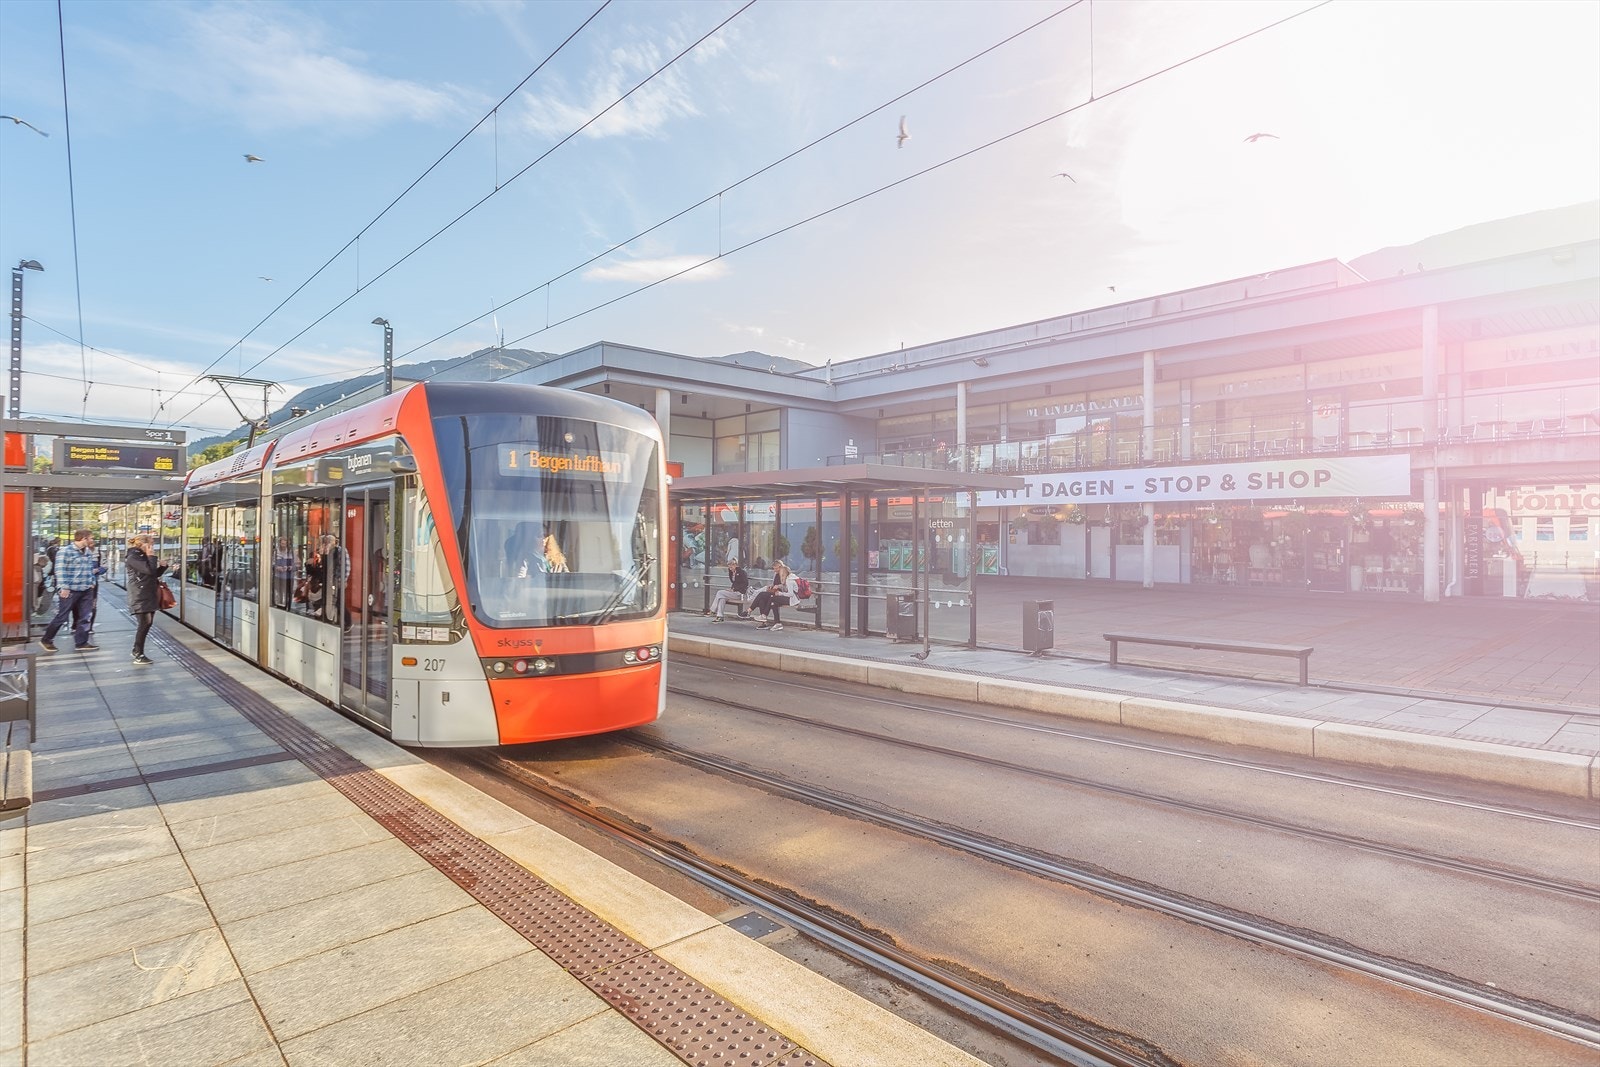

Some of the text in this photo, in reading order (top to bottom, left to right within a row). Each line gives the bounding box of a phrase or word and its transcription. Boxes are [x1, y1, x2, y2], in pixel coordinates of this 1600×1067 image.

[145, 430, 173, 440] Spor 1
[347, 453, 372, 472] bybanen
[508, 450, 518, 468] 1
[529, 450, 573, 473] Bergen
[995, 483, 1033, 499] NYT
[1041, 479, 1114, 498] DAGEN
[1144, 475, 1211, 494] STOP
[1219, 473, 1237, 491] &
[1247, 469, 1332, 491] SHOP
[1508, 486, 1598, 511] tonic
[929, 519, 954, 528] letten
[497, 637, 533, 648] skyss
[424, 658, 446, 672] 207
